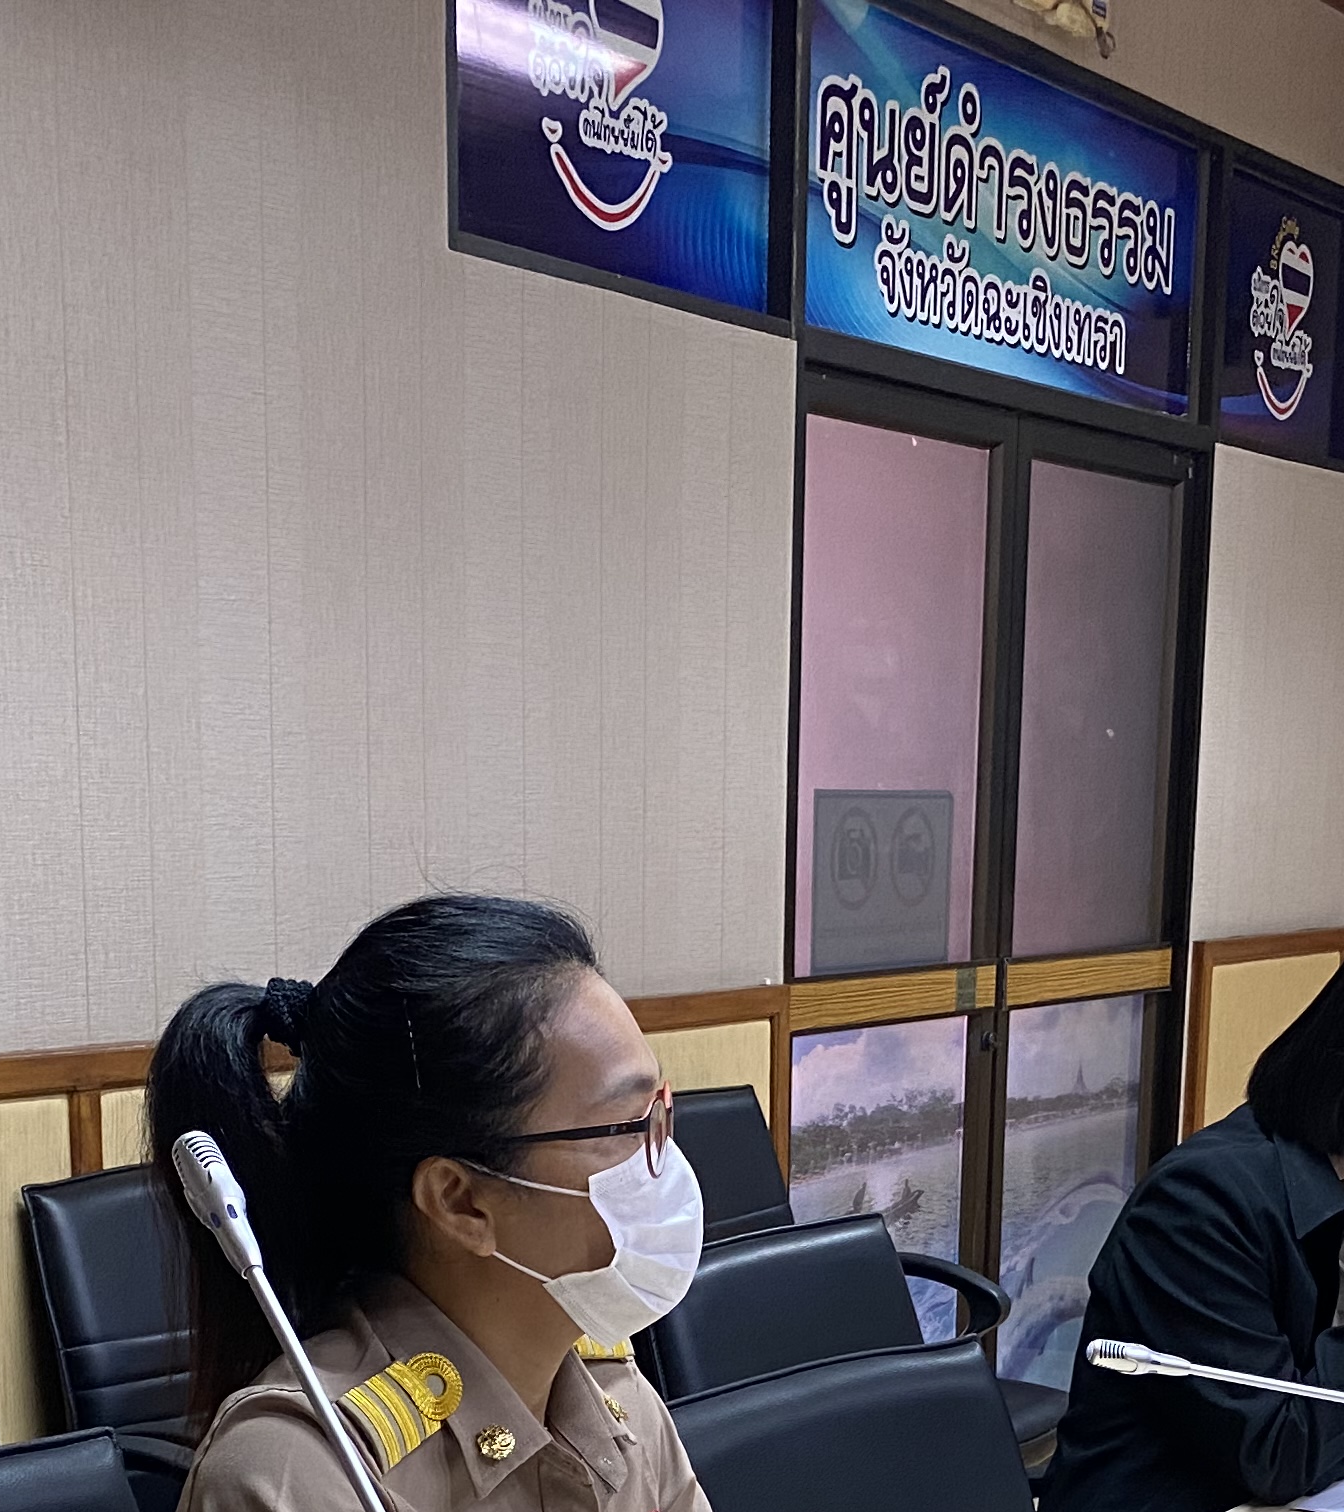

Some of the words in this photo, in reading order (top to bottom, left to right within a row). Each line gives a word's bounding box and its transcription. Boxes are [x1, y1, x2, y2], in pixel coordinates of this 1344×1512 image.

[818, 66, 1175, 295] ศูนย์ดำรงธรรม
[874, 214, 1127, 375] จังหวัดฉะเชิงเทรา
